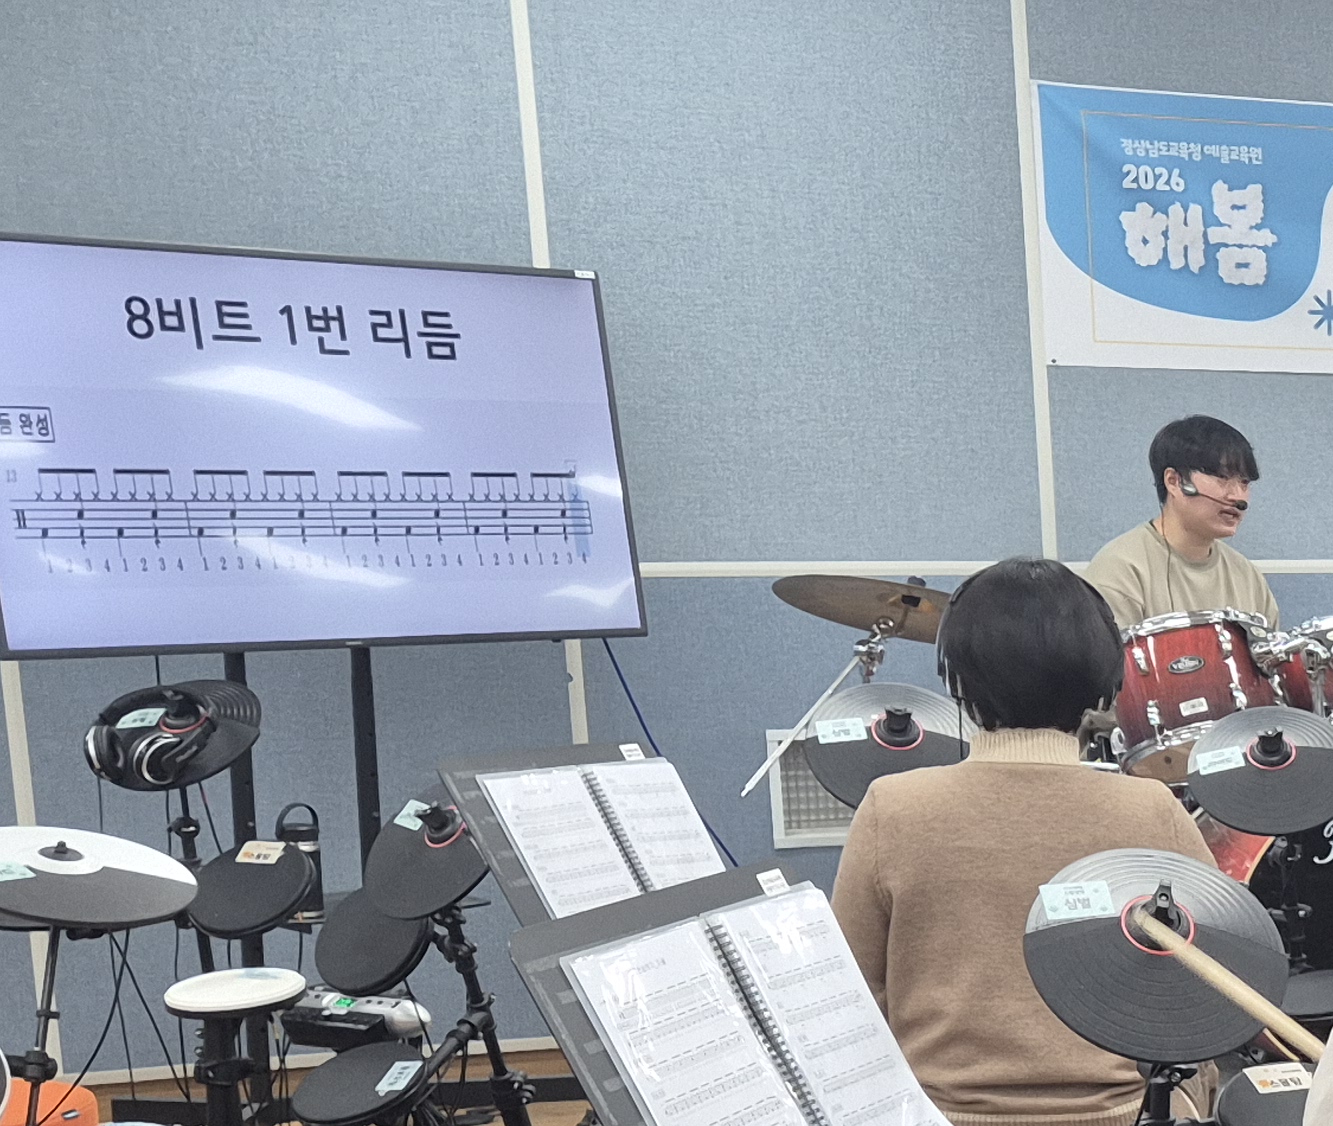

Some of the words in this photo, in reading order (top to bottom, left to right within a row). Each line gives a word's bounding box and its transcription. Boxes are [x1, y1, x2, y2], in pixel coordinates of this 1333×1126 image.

[1120, 138, 1201, 161] 경상남도교육청
[1203, 145, 1263, 164] 예술교육원
[1122, 163, 1185, 192] 2026
[1118, 180, 1278, 286] 해봄
[125, 296, 262, 350] 8비트
[278, 305, 350, 357] 1번
[369, 309, 461, 361] 리듬
[19, 412, 50, 437] 완성
